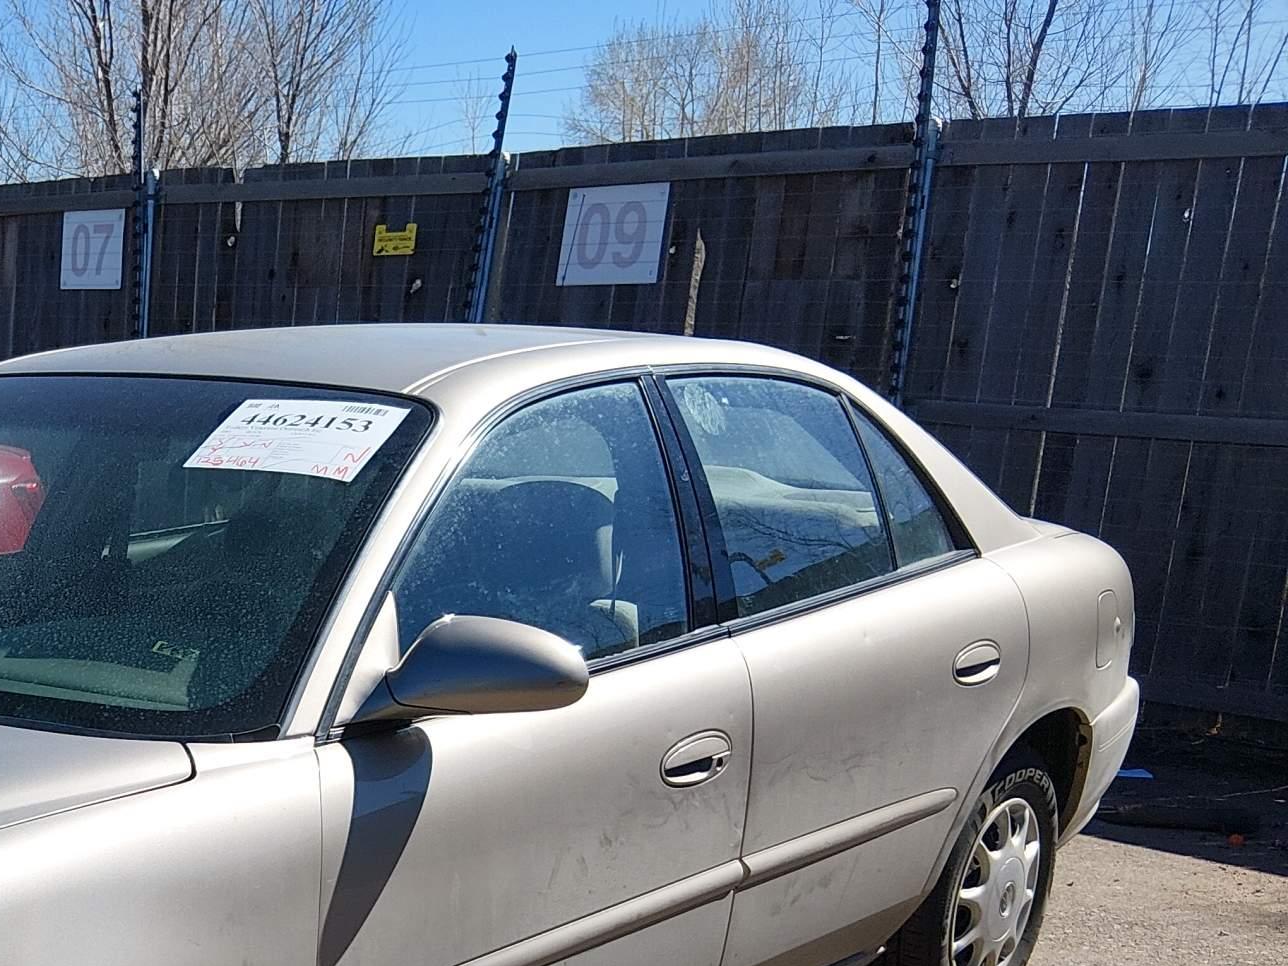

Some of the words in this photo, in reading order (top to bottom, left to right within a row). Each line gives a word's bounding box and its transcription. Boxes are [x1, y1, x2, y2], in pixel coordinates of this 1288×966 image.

[72, 223, 114, 277] 07
[577, 201, 647, 270] 09
[241, 412, 373, 433] 44624153
[995, 767, 1050, 803] COOPER
